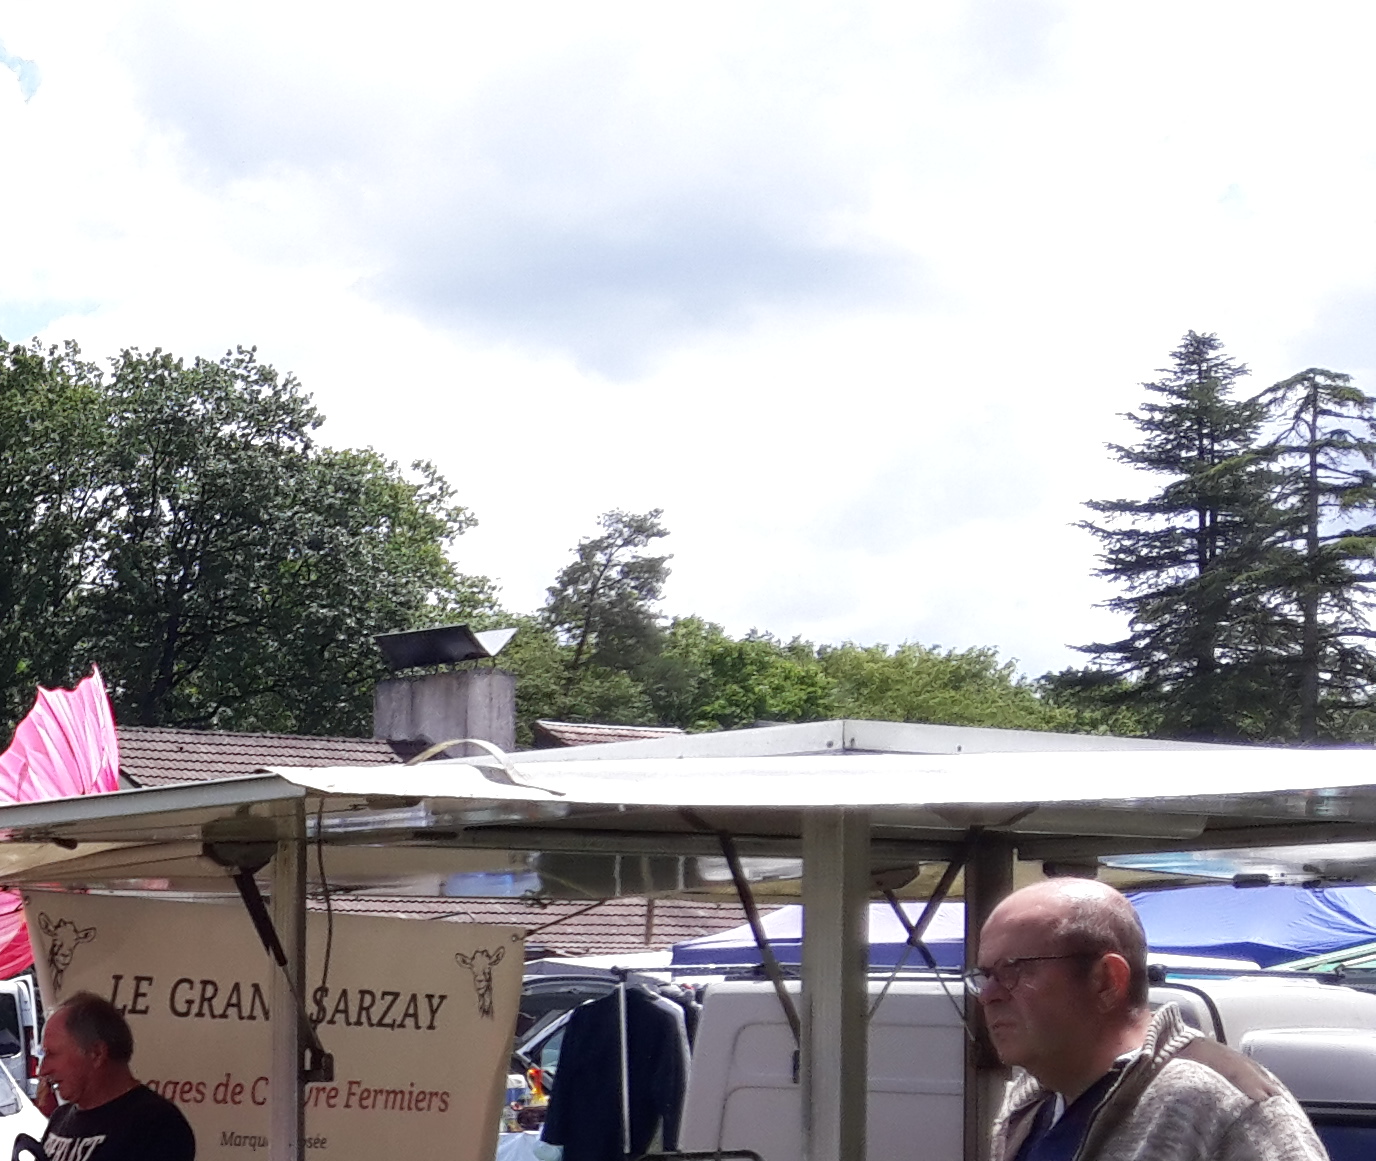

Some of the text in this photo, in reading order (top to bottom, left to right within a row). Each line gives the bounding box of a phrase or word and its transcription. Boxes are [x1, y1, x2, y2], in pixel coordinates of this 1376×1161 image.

[111, 974, 448, 1031] LE GRAN SARZAY
[213, 1073, 244, 1104] de
[346, 1079, 450, 1113] Fermiers
[220, 1131, 269, 1151] Marqu
